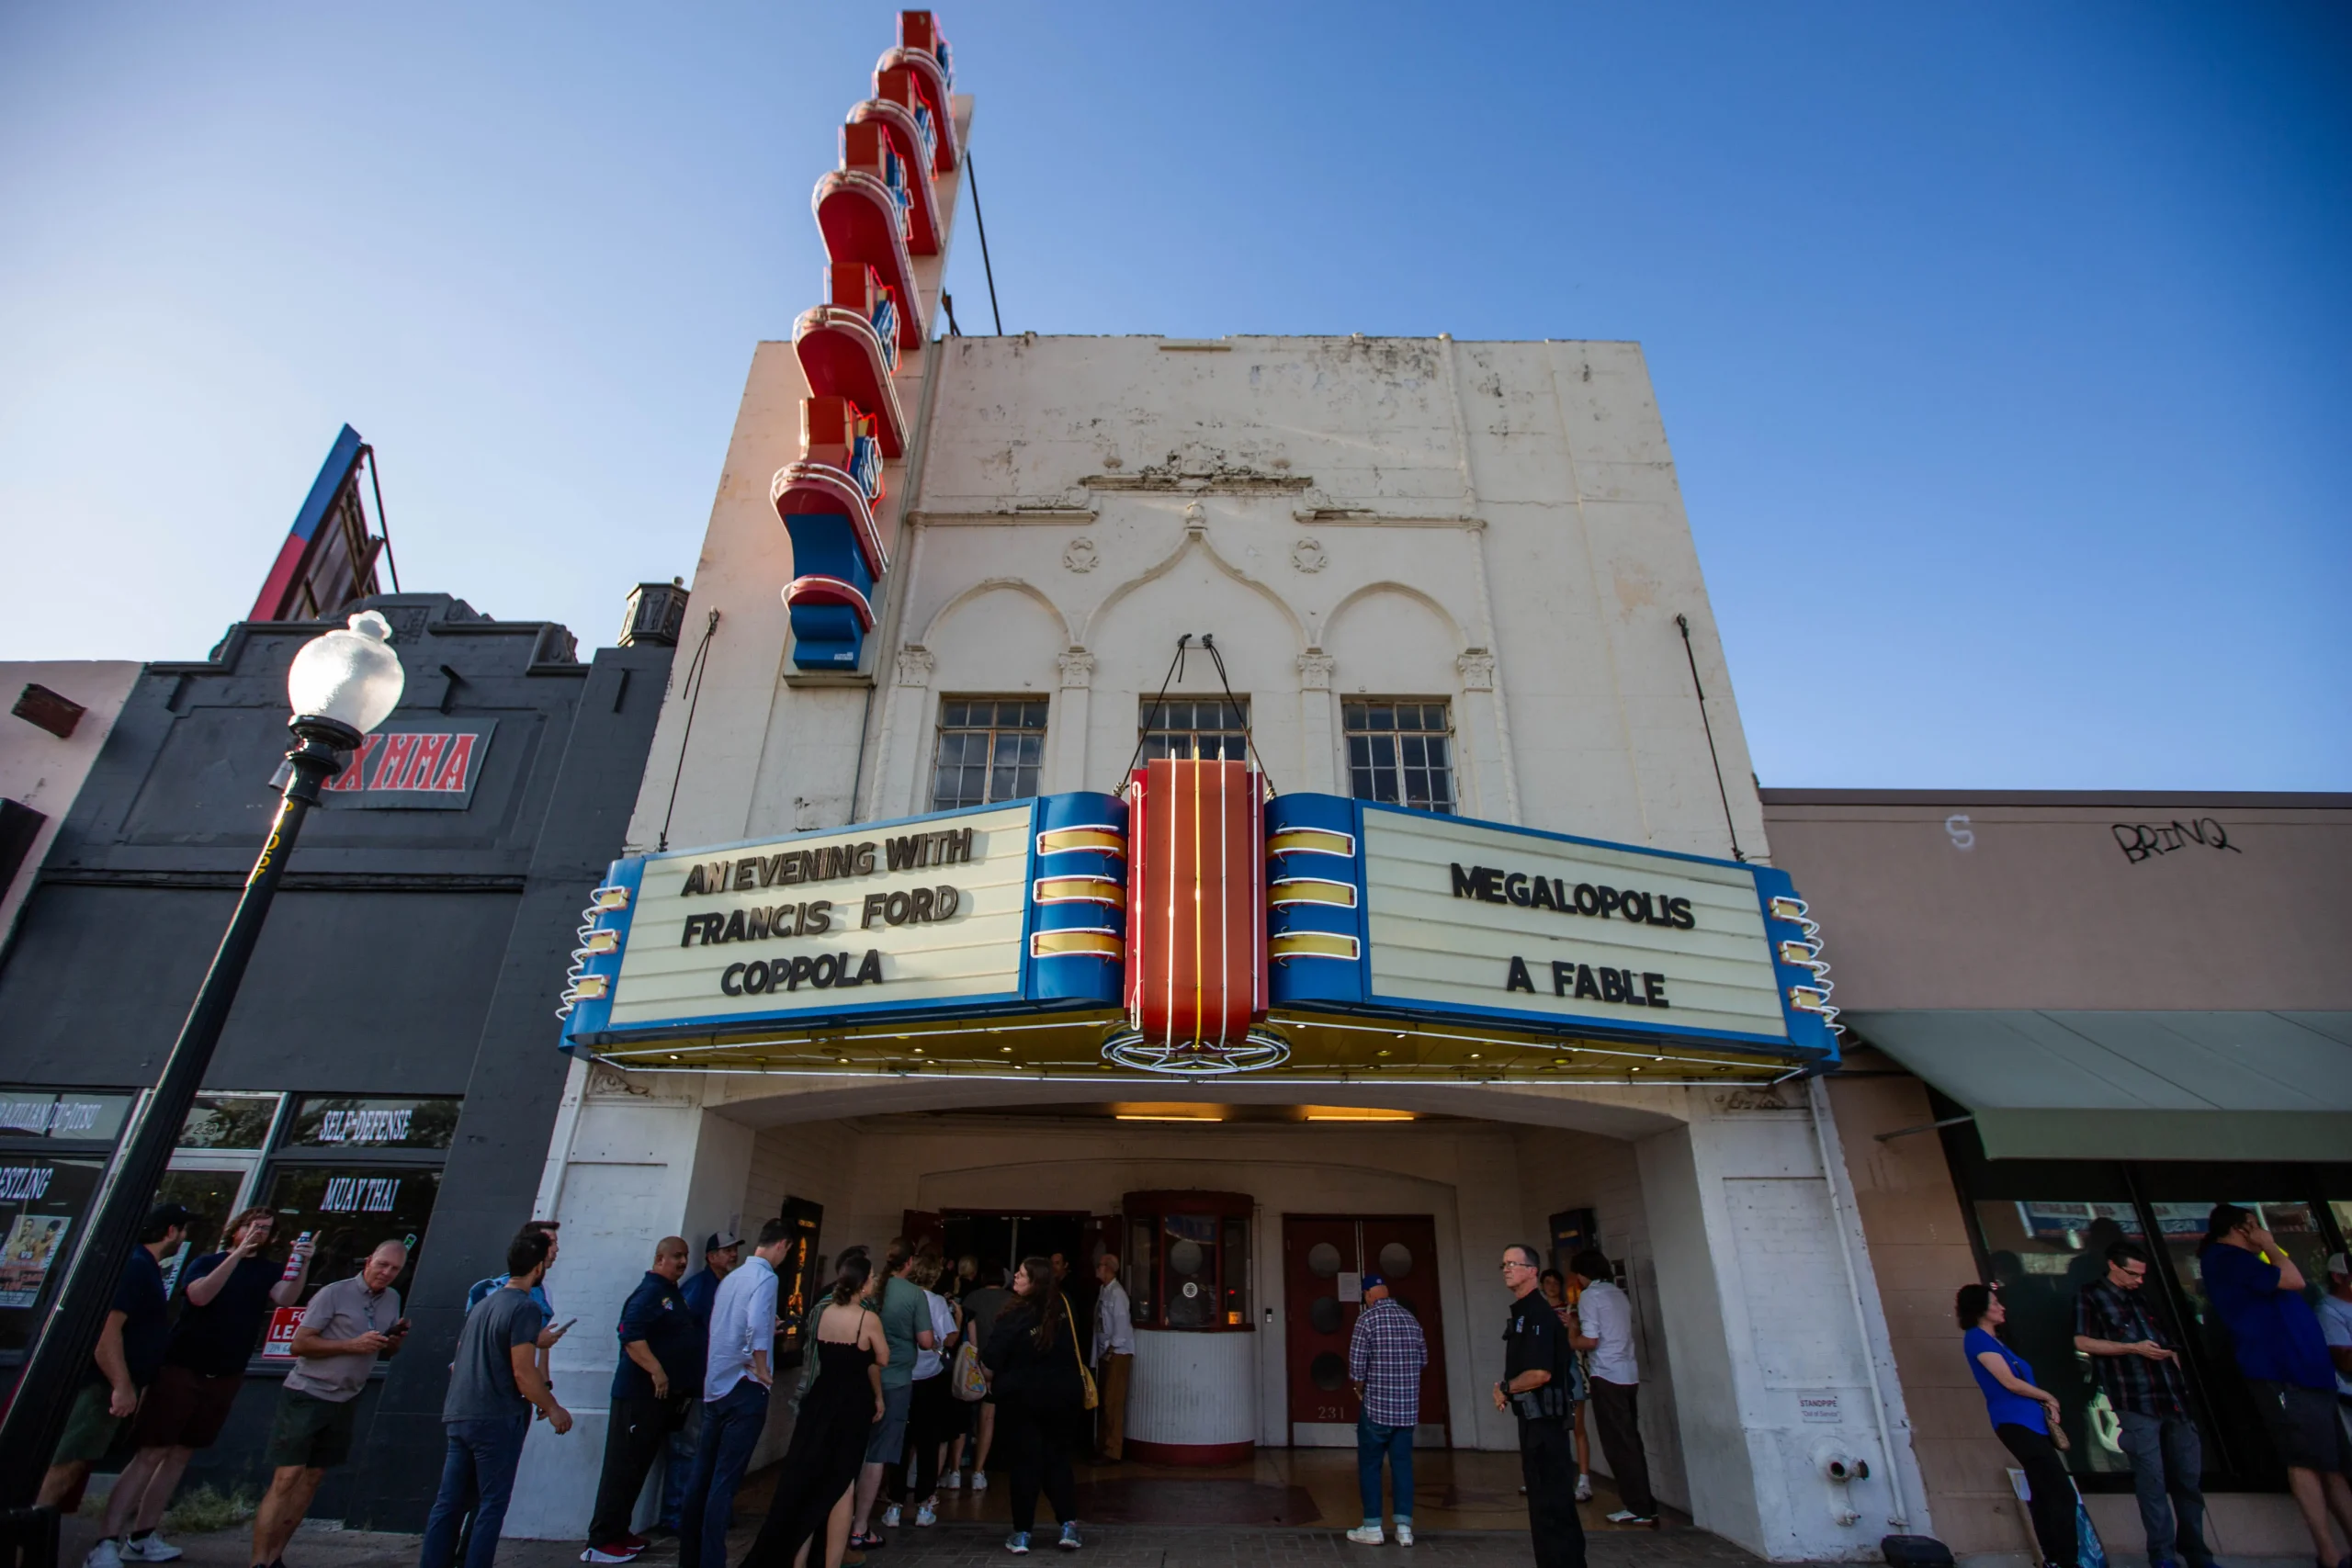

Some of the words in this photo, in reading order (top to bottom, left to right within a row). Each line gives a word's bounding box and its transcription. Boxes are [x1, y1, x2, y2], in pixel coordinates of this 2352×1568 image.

[1945, 815, 1974, 850] S
[681, 861, 729, 897] AN
[732, 841, 876, 891] EVENING
[885, 827, 972, 871] WITH
[1450, 863, 1695, 930] MEGALOPOLIS
[681, 900, 831, 947] FRANCIS
[860, 885, 958, 929] FORD
[720, 949, 882, 997] COPPOLA
[1507, 955, 1535, 993] A
[1552, 961, 1669, 1009] FABLE
[319, 1110, 413, 1141] SELF-DEFENSE
[0, 1167, 54, 1200] ESTLING
[319, 1178, 367, 1211] MUAY
[362, 1178, 401, 1212] THAI
[291, 1311, 307, 1322] FO
[1317, 1405, 1344, 1419] 231
[1800, 1399, 1838, 1407] STANDPIPE
